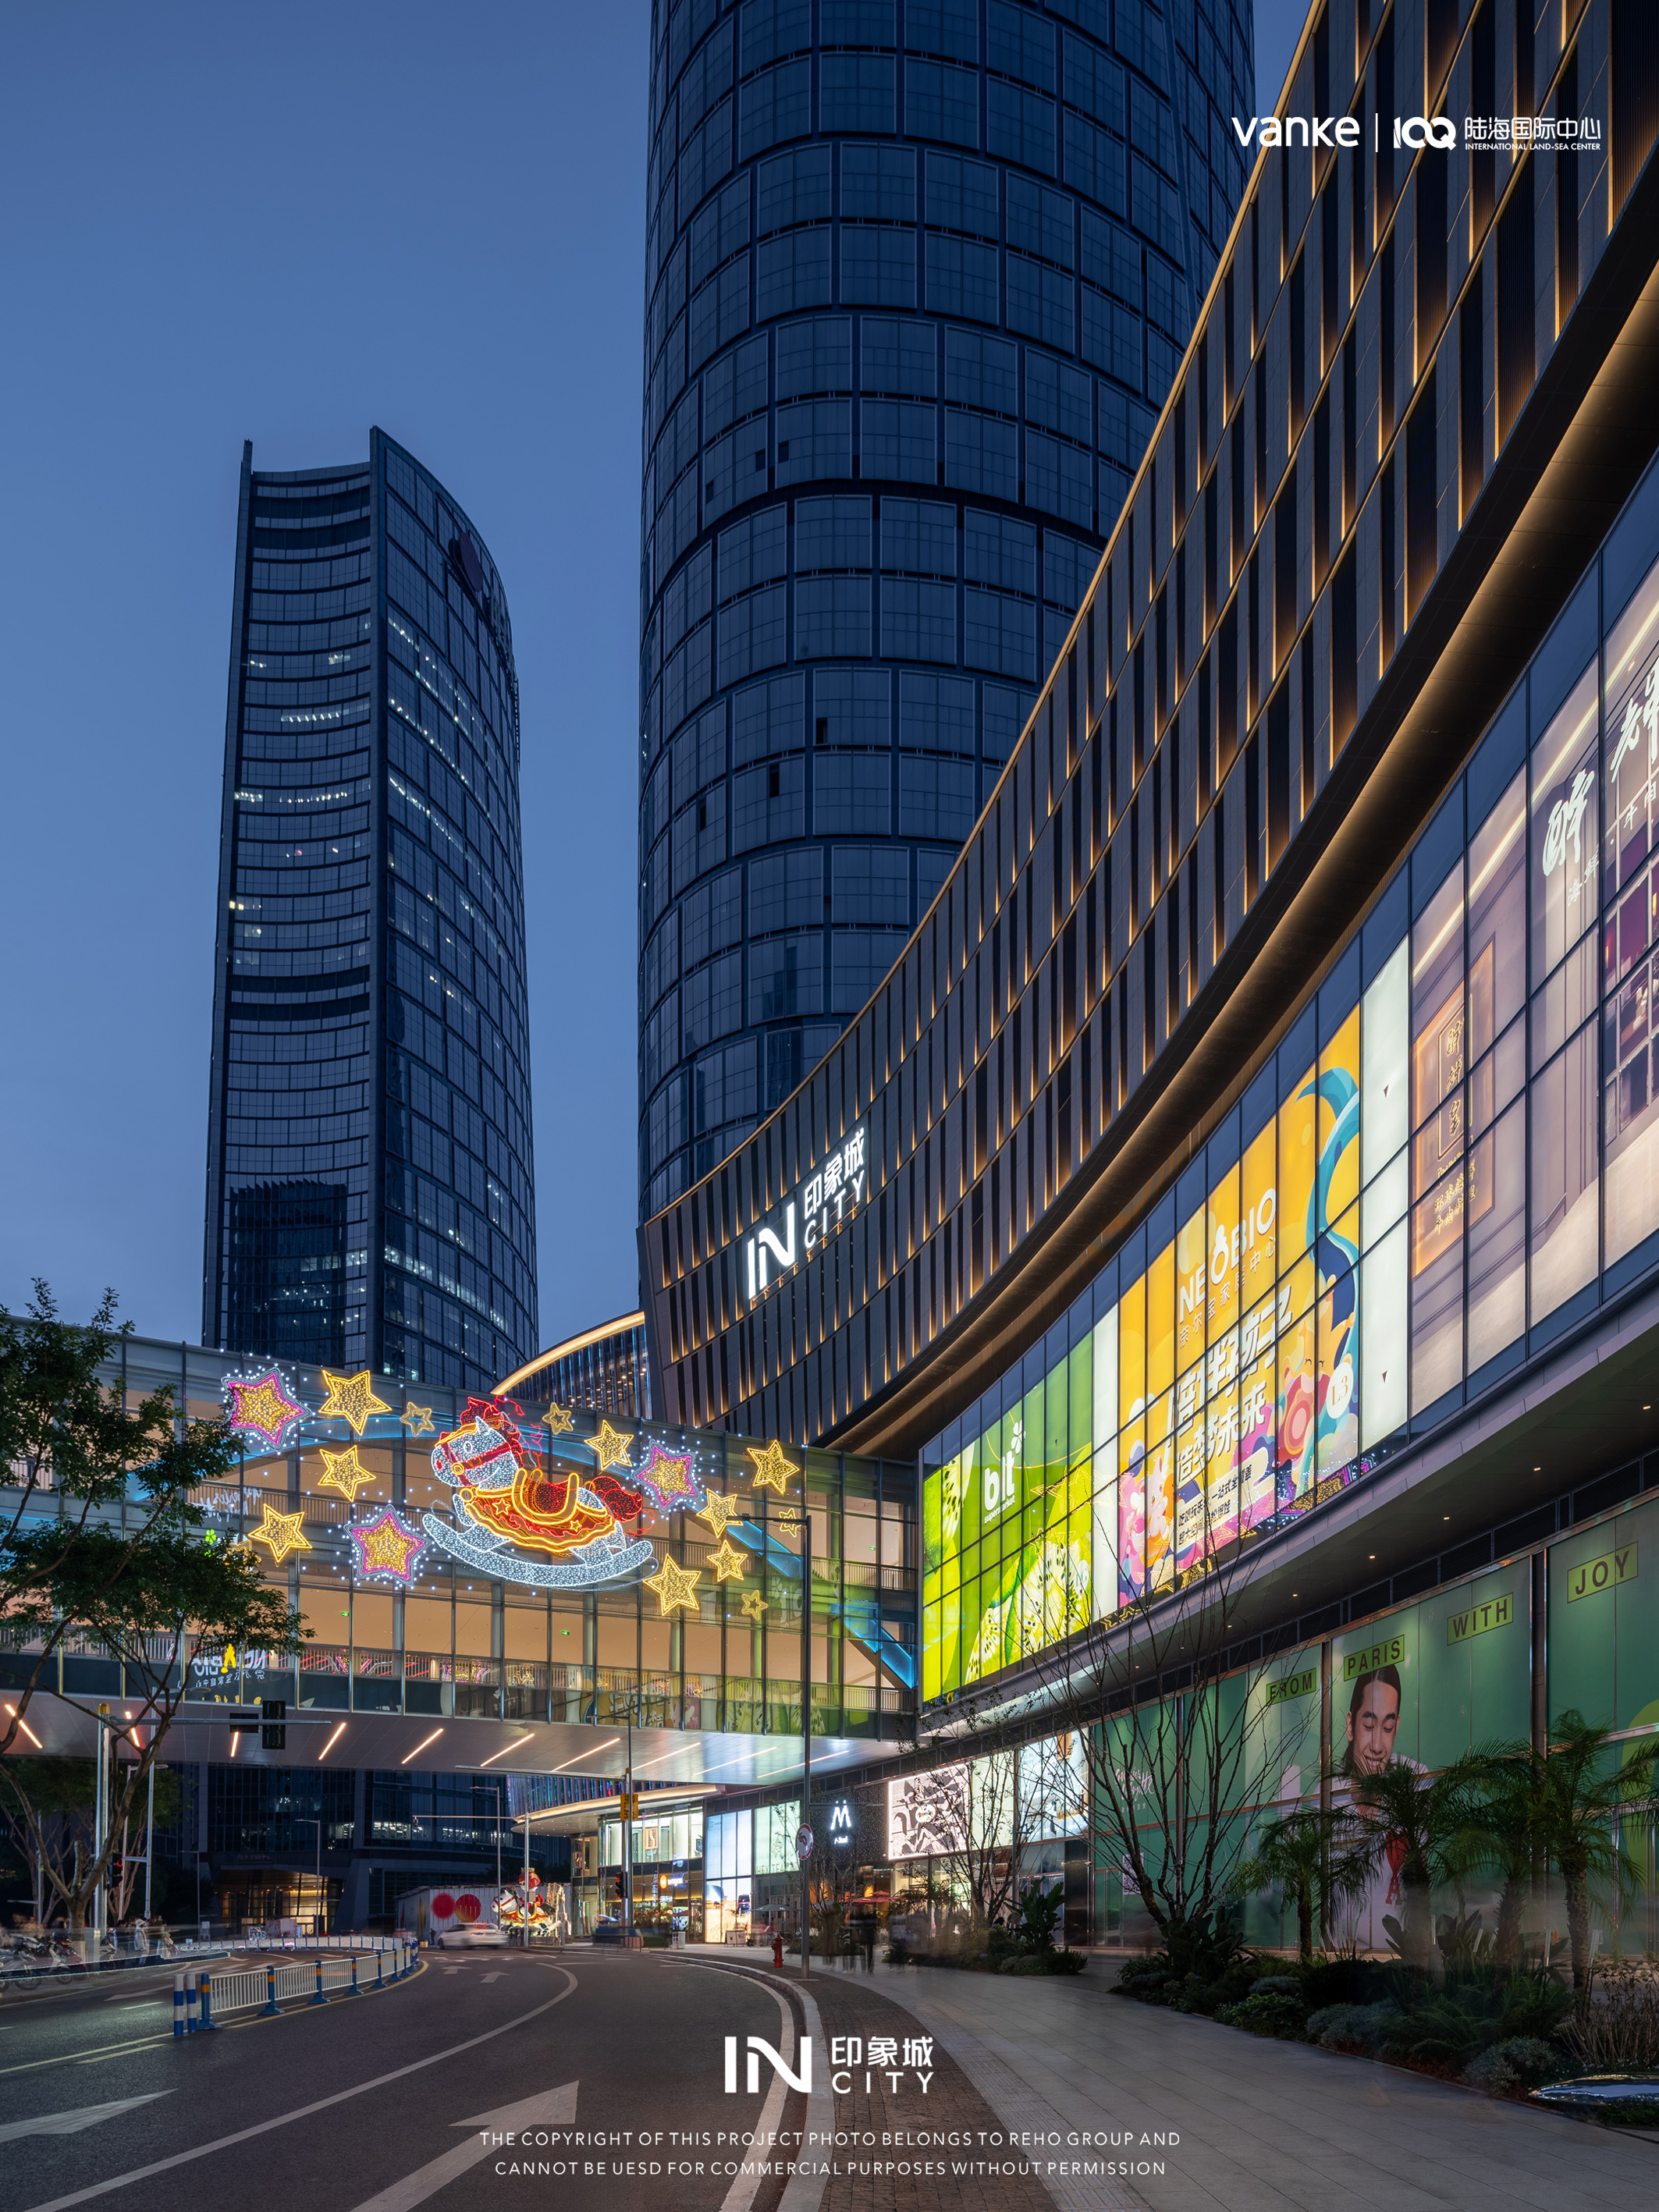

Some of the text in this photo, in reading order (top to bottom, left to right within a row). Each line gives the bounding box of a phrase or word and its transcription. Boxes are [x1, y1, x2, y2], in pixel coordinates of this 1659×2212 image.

[804, 1127, 865, 1220] 印象城
[805, 1170, 865, 1249] CITY
[1179, 1188, 1277, 1325] NEOBIO
[1161, 1284, 1292, 1479] 陪伴孩子
[1331, 1375, 1348, 1407] L3
[1176, 1378, 1266, 1490] 造梦未来
[984, 1494, 1015, 1524] supermarket
[1575, 1550, 1630, 1596] JOY
[1452, 1599, 1508, 1639] WITH
[1348, 1639, 1401, 1677] PARIS
[1270, 1672, 1313, 1700] FROM
